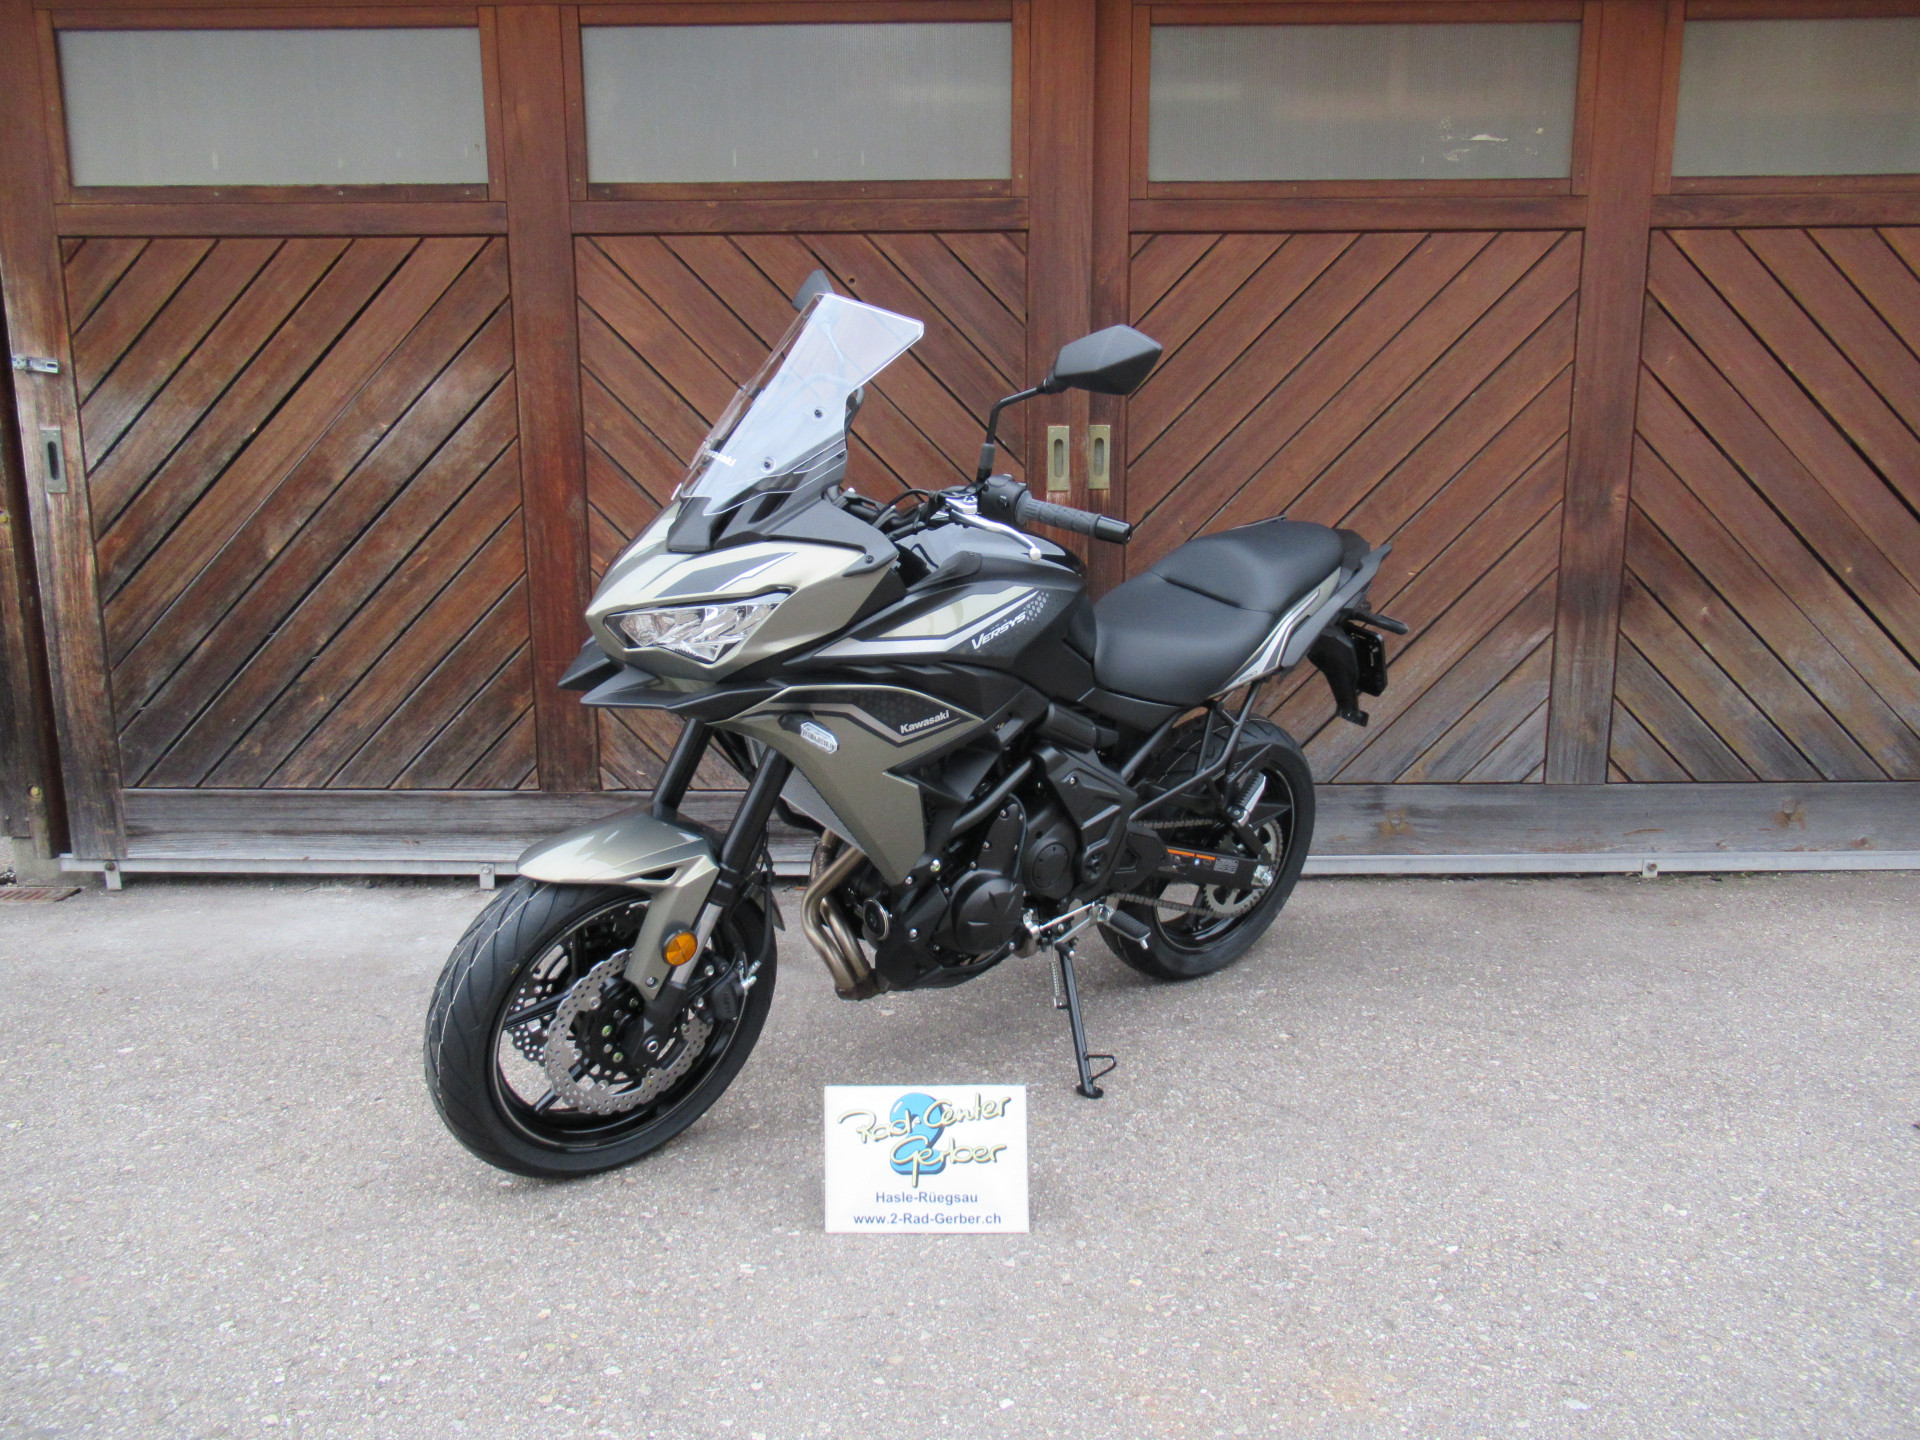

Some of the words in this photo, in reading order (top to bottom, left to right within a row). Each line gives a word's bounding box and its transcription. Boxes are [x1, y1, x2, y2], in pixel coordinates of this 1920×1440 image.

[971, 611, 1026, 650] VERSYS
[900, 709, 950, 734] Kawasaki
[889, 1136, 1008, 1188] Gerber
[875, 1191, 978, 1206] Hasle-Rüegsau
[853, 1213, 1002, 1225] www.2-Rad-Gerber.ch
